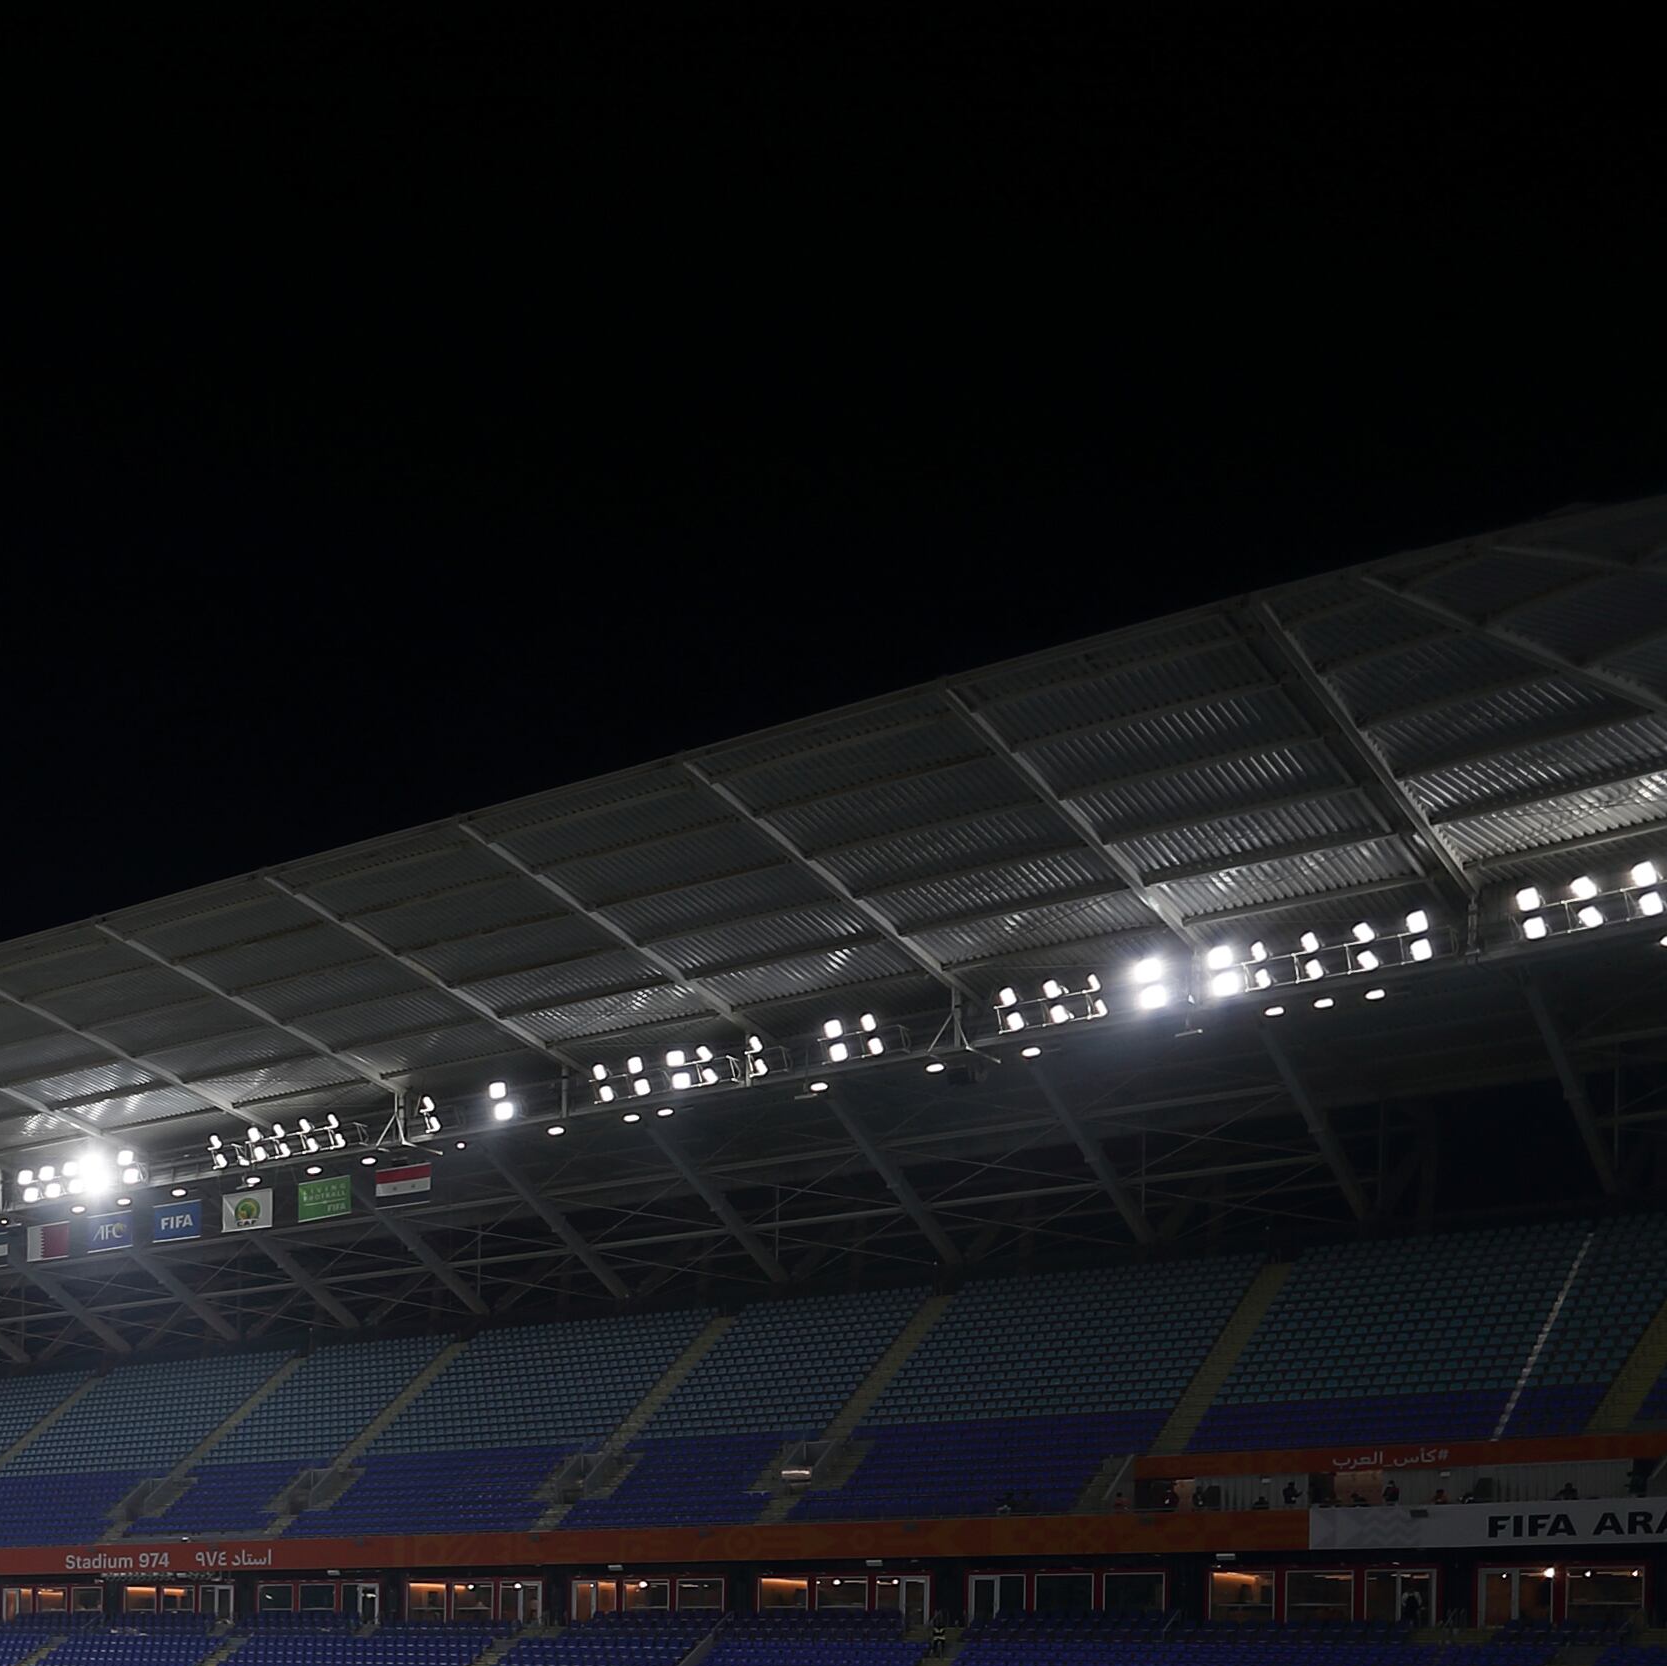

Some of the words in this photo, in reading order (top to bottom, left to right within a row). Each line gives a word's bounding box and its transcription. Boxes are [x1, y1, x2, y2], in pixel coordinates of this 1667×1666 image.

[327, 1204, 347, 1212] FIFA
[93, 1222, 125, 1241] AFC
[161, 1214, 193, 1231] FIFA
[1488, 1514, 1577, 1538] FIFA
[65, 1553, 133, 1570] Stadium
[139, 1552, 170, 1568] 974
[195, 1550, 227, 1567] ٩٧٤
[231, 1549, 272, 1567] استاد
